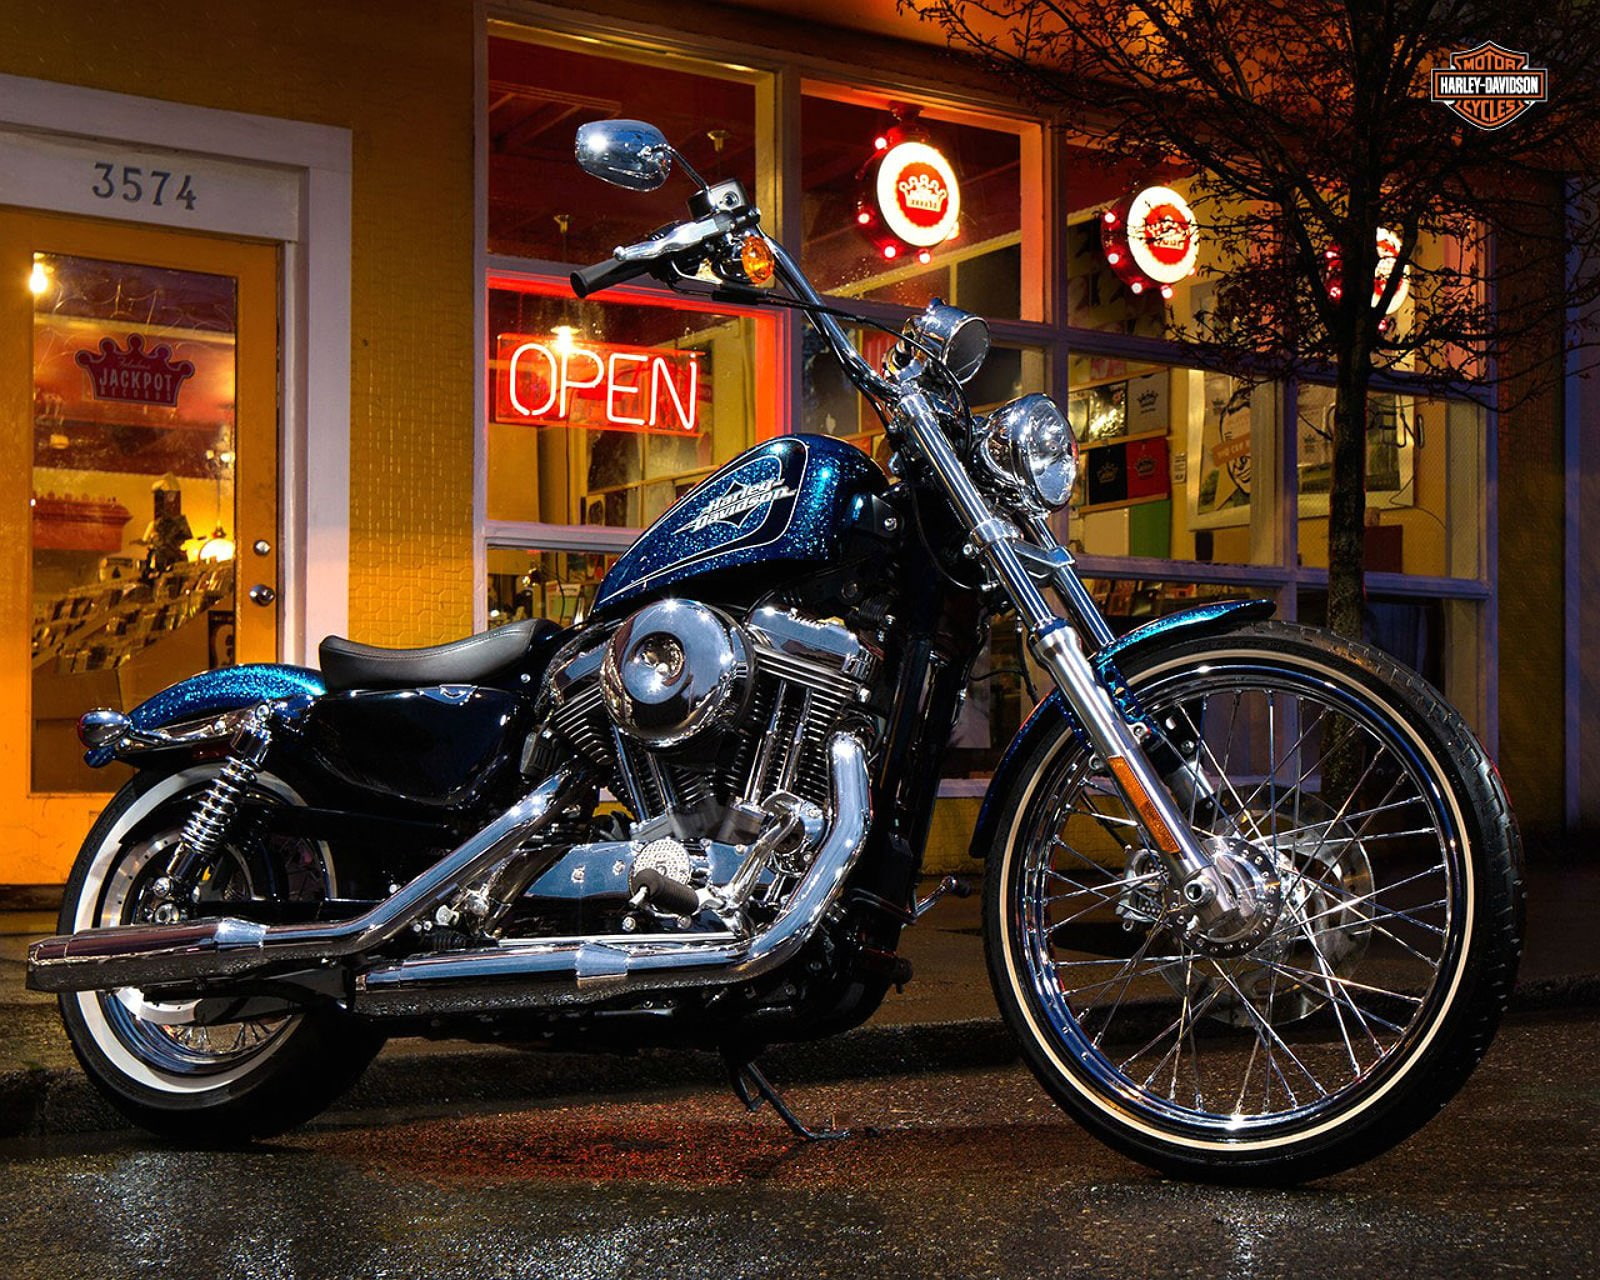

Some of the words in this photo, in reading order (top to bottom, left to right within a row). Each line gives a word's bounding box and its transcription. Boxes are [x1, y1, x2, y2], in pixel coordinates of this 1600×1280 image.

[91, 162, 198, 211] 3574
[99, 367, 173, 392] JACKPOT
[509, 342, 698, 430] OPEN
[671, 486, 797, 534] Davidson
[701, 478, 785, 515] Harley
